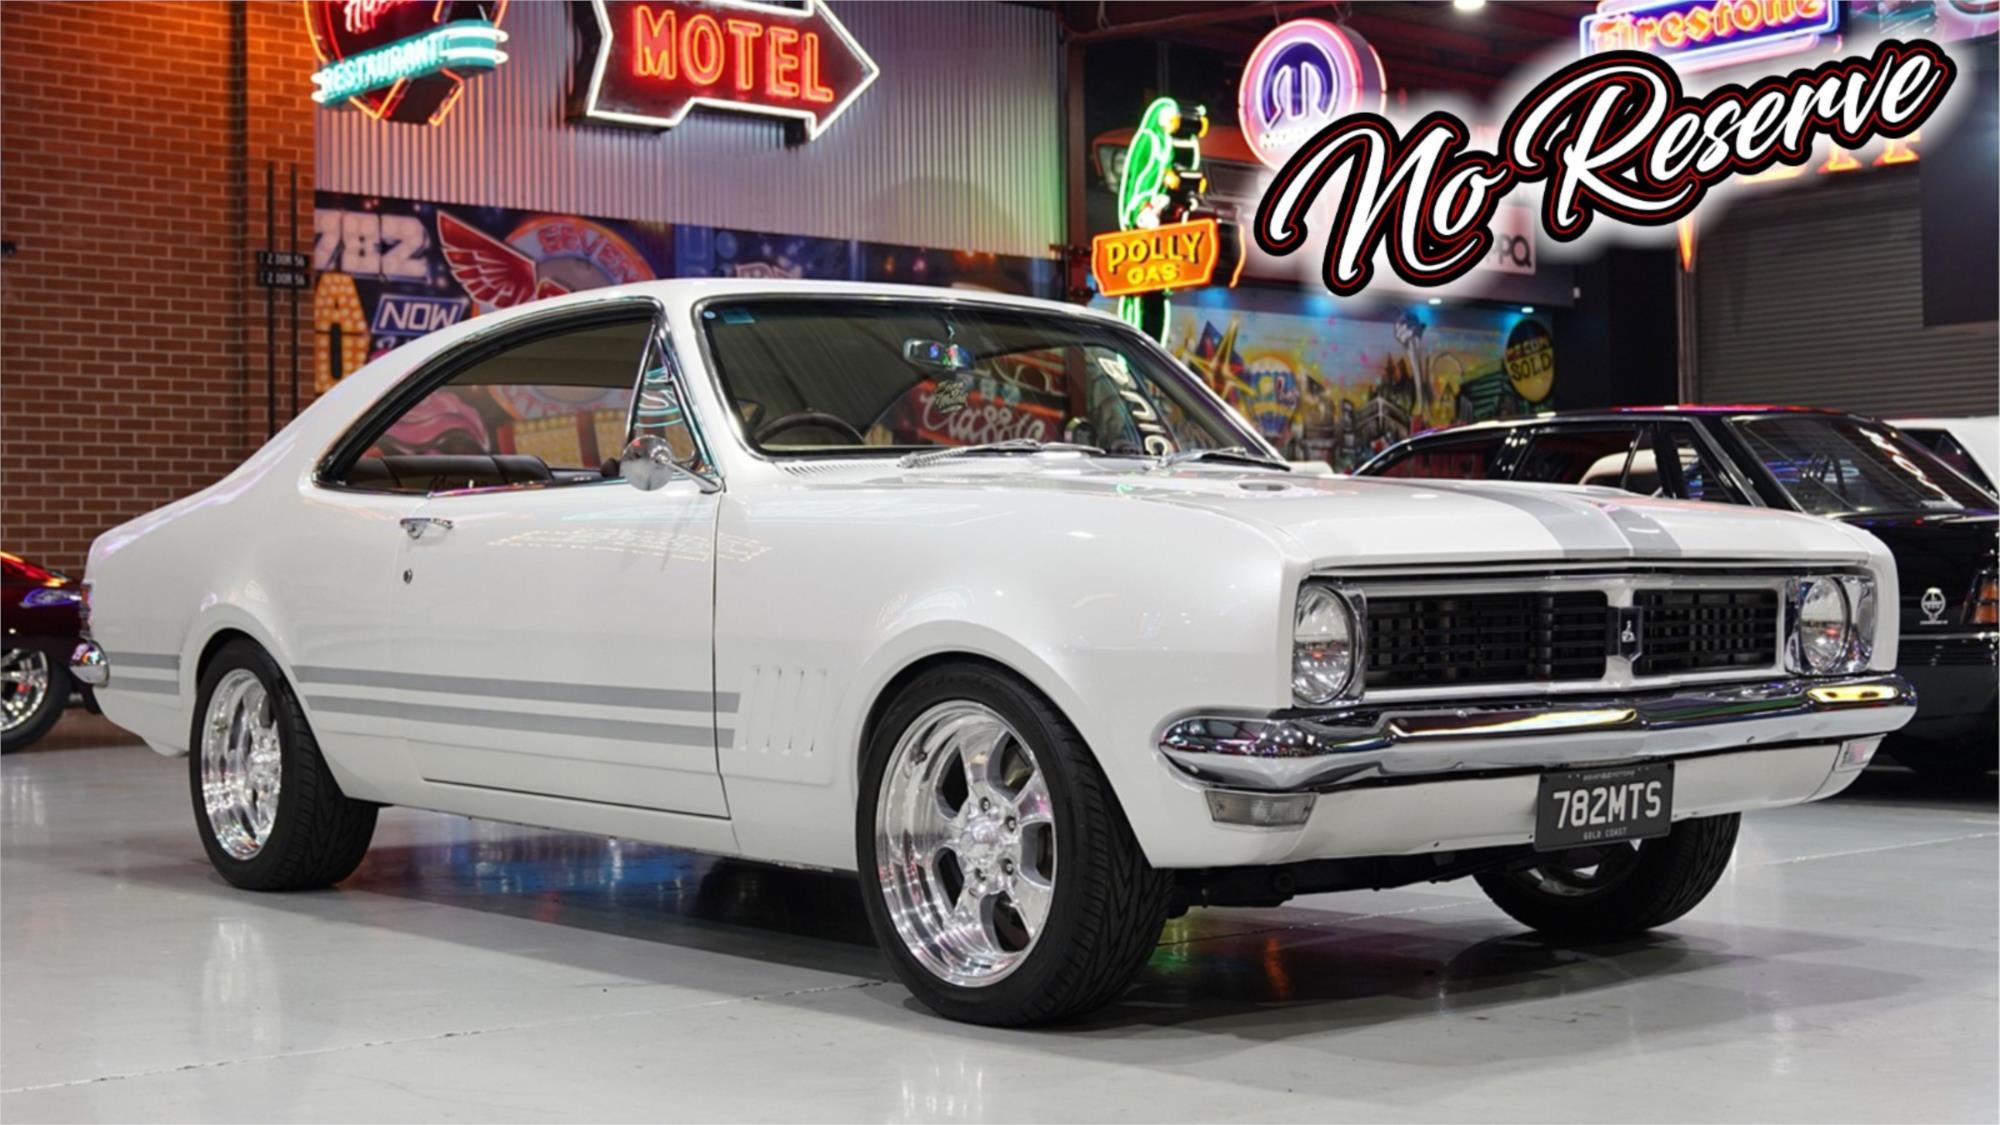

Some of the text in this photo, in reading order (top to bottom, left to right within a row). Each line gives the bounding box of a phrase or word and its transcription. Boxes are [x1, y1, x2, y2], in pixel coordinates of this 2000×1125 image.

[321, 32, 440, 96] RESTAURANT
[634, 4, 834, 102] MOTEL
[314, 208, 431, 281] 782
[1105, 231, 1204, 273] POLLY
[1126, 265, 1178, 285] GAS
[378, 300, 459, 332] NOW
[1510, 352, 1551, 382] SOLD
[1553, 780, 1662, 829] 782MTS
[1583, 826, 1628, 840] GOLD COAST
